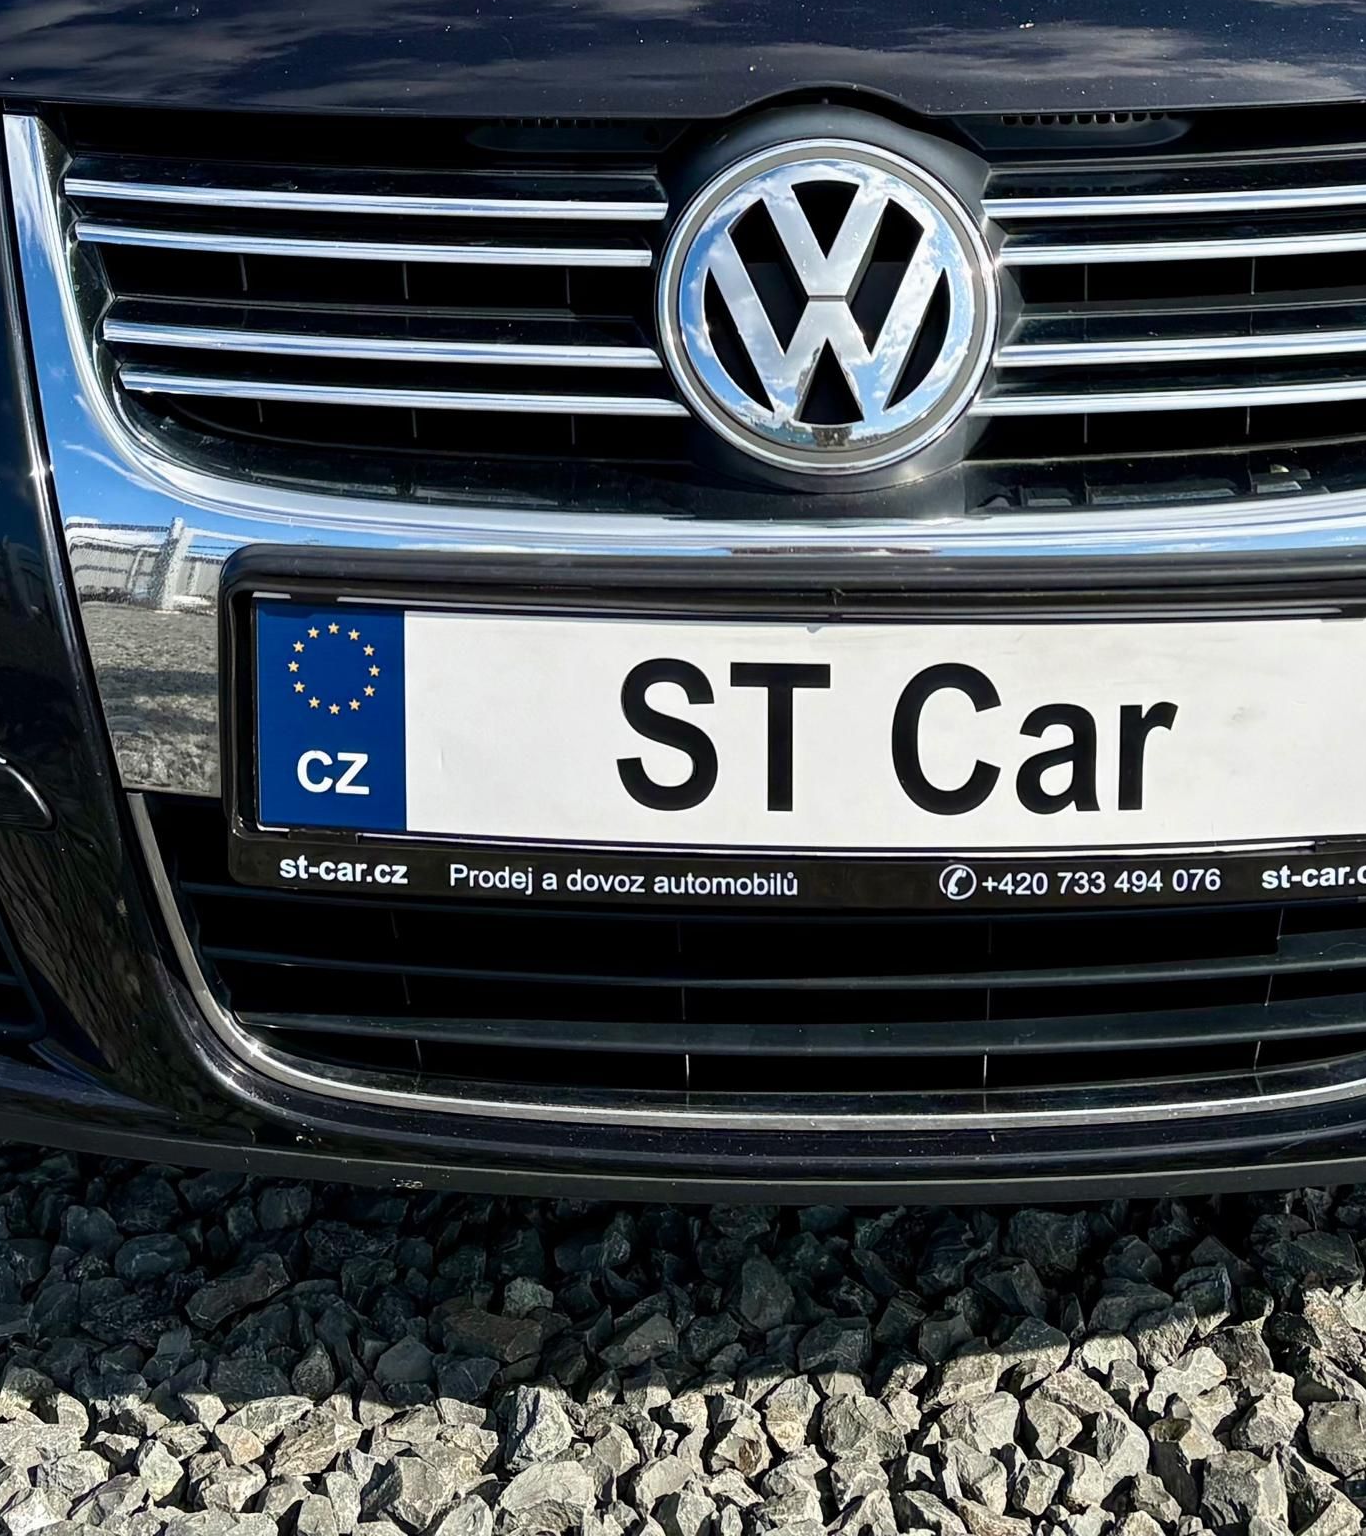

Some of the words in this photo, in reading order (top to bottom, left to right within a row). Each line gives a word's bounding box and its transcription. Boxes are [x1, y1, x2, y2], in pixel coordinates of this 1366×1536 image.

[679, 159, 974, 451] VW
[616, 657, 831, 812] ST
[891, 662, 1179, 816] Car
[296, 749, 370, 795] CZ
[279, 854, 409, 885] st-car.cz
[449, 863, 533, 896] Prodej
[541, 872, 558, 891] a
[566, 868, 646, 893] dovoz
[653, 871, 798, 896] automobilů
[981, 872, 1049, 895] +420
[1056, 871, 1107, 895] 733
[1113, 869, 1164, 893] 494
[1172, 867, 1221, 892] 076
